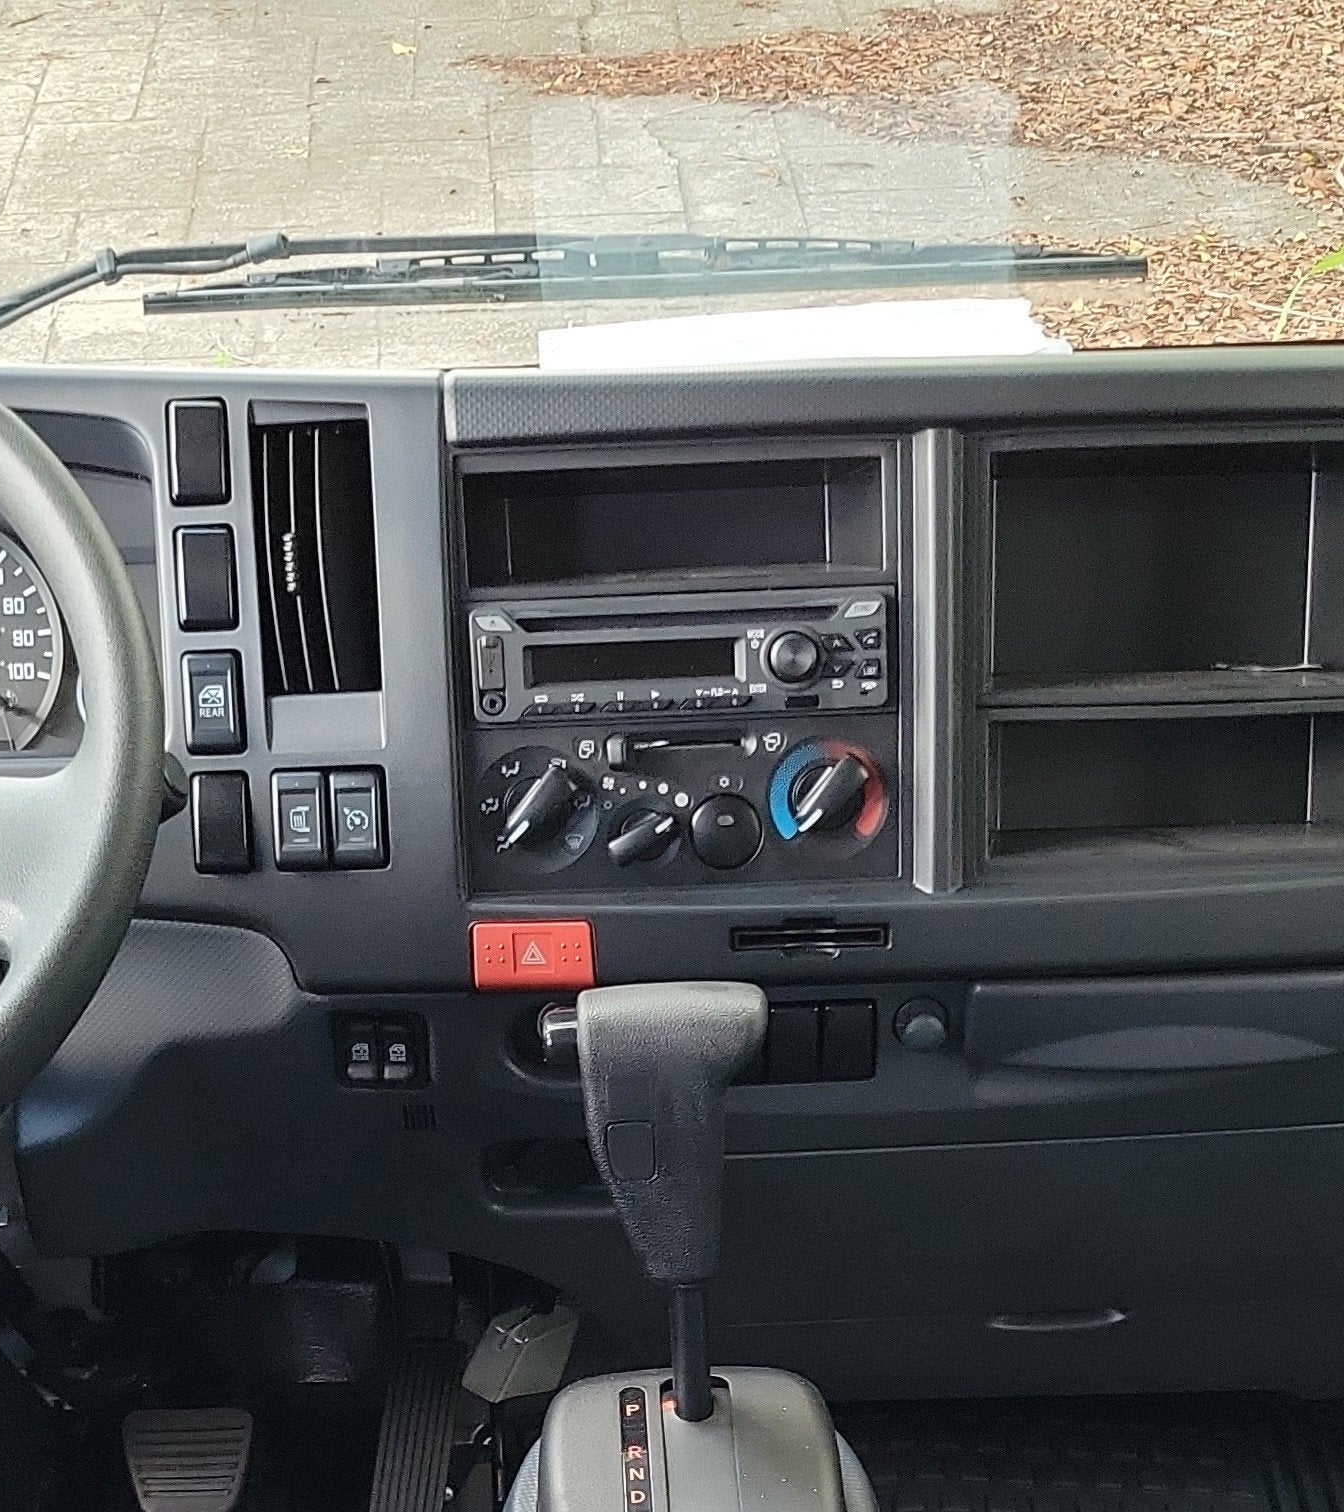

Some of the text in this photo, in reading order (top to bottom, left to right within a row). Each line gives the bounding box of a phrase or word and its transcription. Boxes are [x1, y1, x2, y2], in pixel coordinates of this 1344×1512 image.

[3, 598, 24, 614] 80
[8, 663, 34, 680] 100
[200, 707, 225, 717] REAR
[625, 1404, 640, 1416] P
[627, 1446, 643, 1459] R
[629, 1467, 645, 1480] N
[631, 1490, 646, 1503] D
